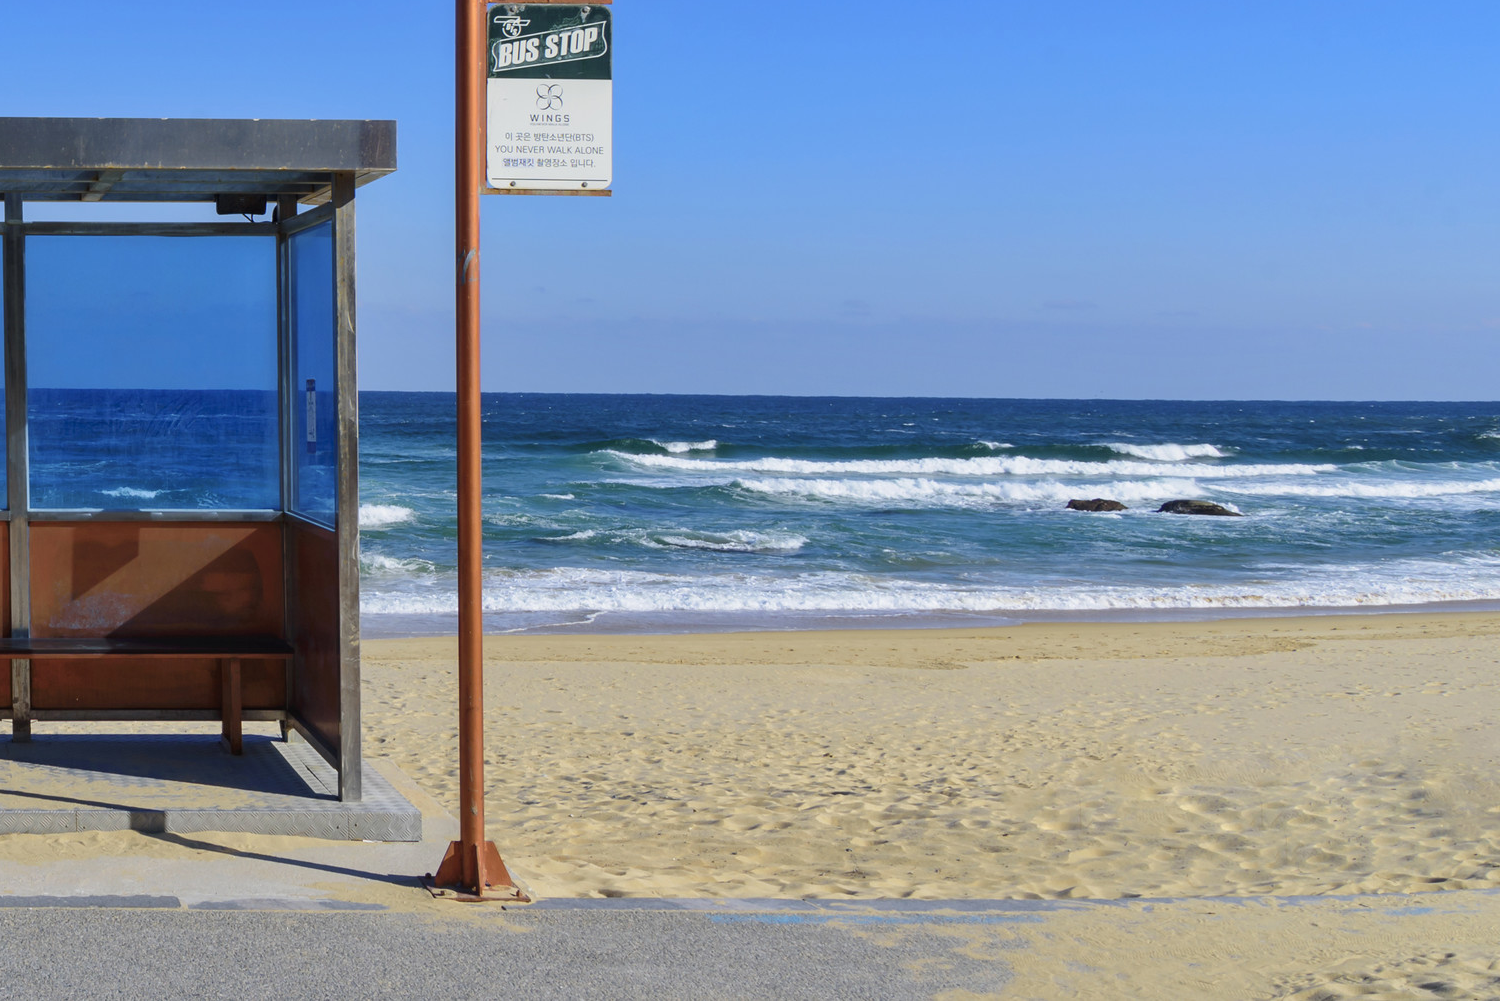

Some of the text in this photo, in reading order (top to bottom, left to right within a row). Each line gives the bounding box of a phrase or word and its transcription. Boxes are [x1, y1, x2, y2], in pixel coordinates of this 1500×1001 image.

[505, 23, 518, 36] BTS
[498, 27, 598, 68] BUS STOP
[529, 114, 570, 123] WINGS
[505, 132, 595, 143] 이 곳은 방탄소년단(BTS)
[495, 145, 604, 155] YOU NEVER WALK ALONE
[570, 159, 596, 169] 입니다.
